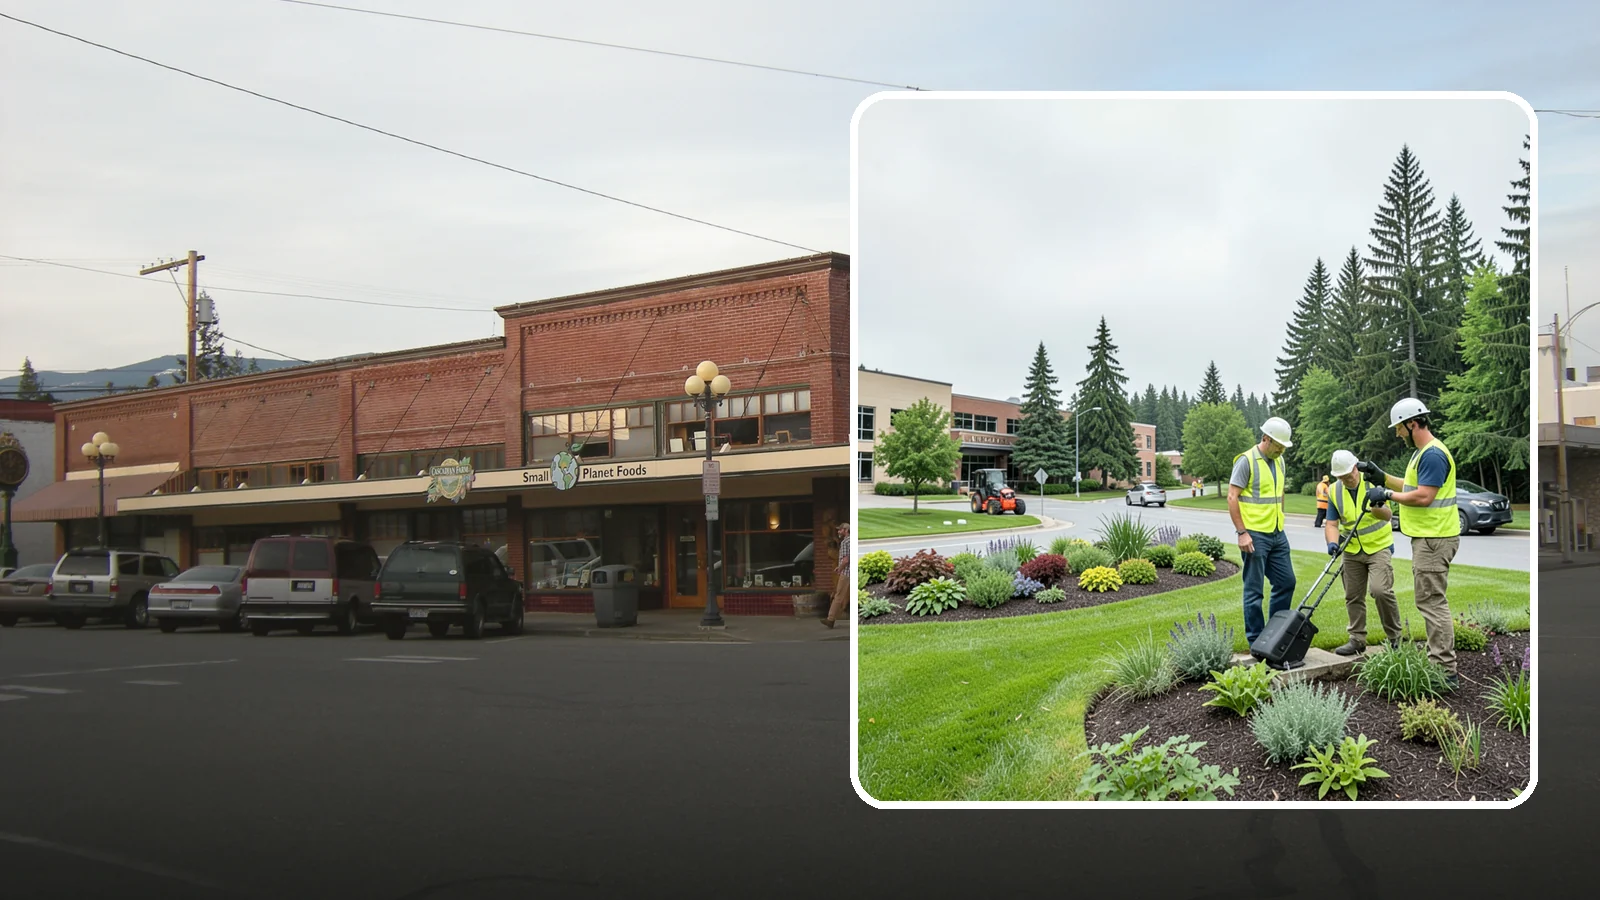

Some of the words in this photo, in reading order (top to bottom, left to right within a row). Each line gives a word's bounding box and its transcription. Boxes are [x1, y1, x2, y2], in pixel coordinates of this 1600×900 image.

[523, 471, 549, 483] Small
[583, 467, 614, 479] Planet
[617, 464, 647, 477] Foods
